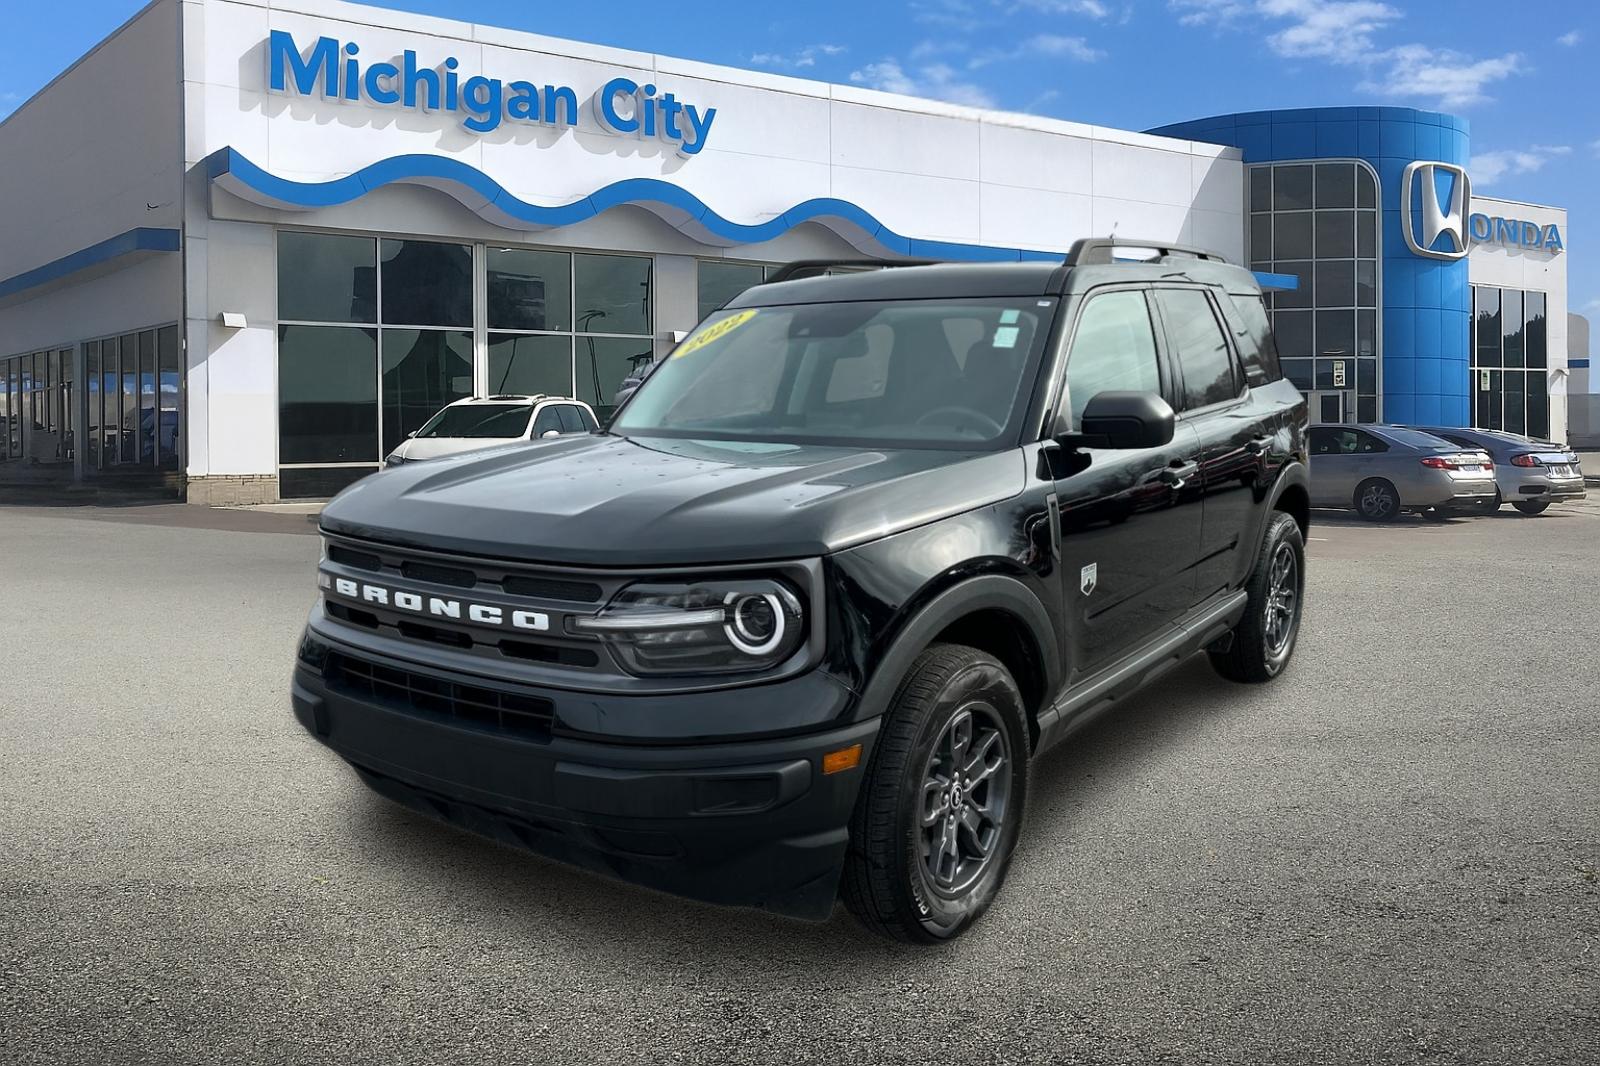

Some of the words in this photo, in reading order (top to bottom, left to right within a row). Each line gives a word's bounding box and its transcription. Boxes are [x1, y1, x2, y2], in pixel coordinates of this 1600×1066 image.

[269, 29, 578, 133] Michigan
[600, 78, 717, 154] City
[1469, 212, 1564, 250] ONDA
[335, 578, 550, 631] BRONCO
